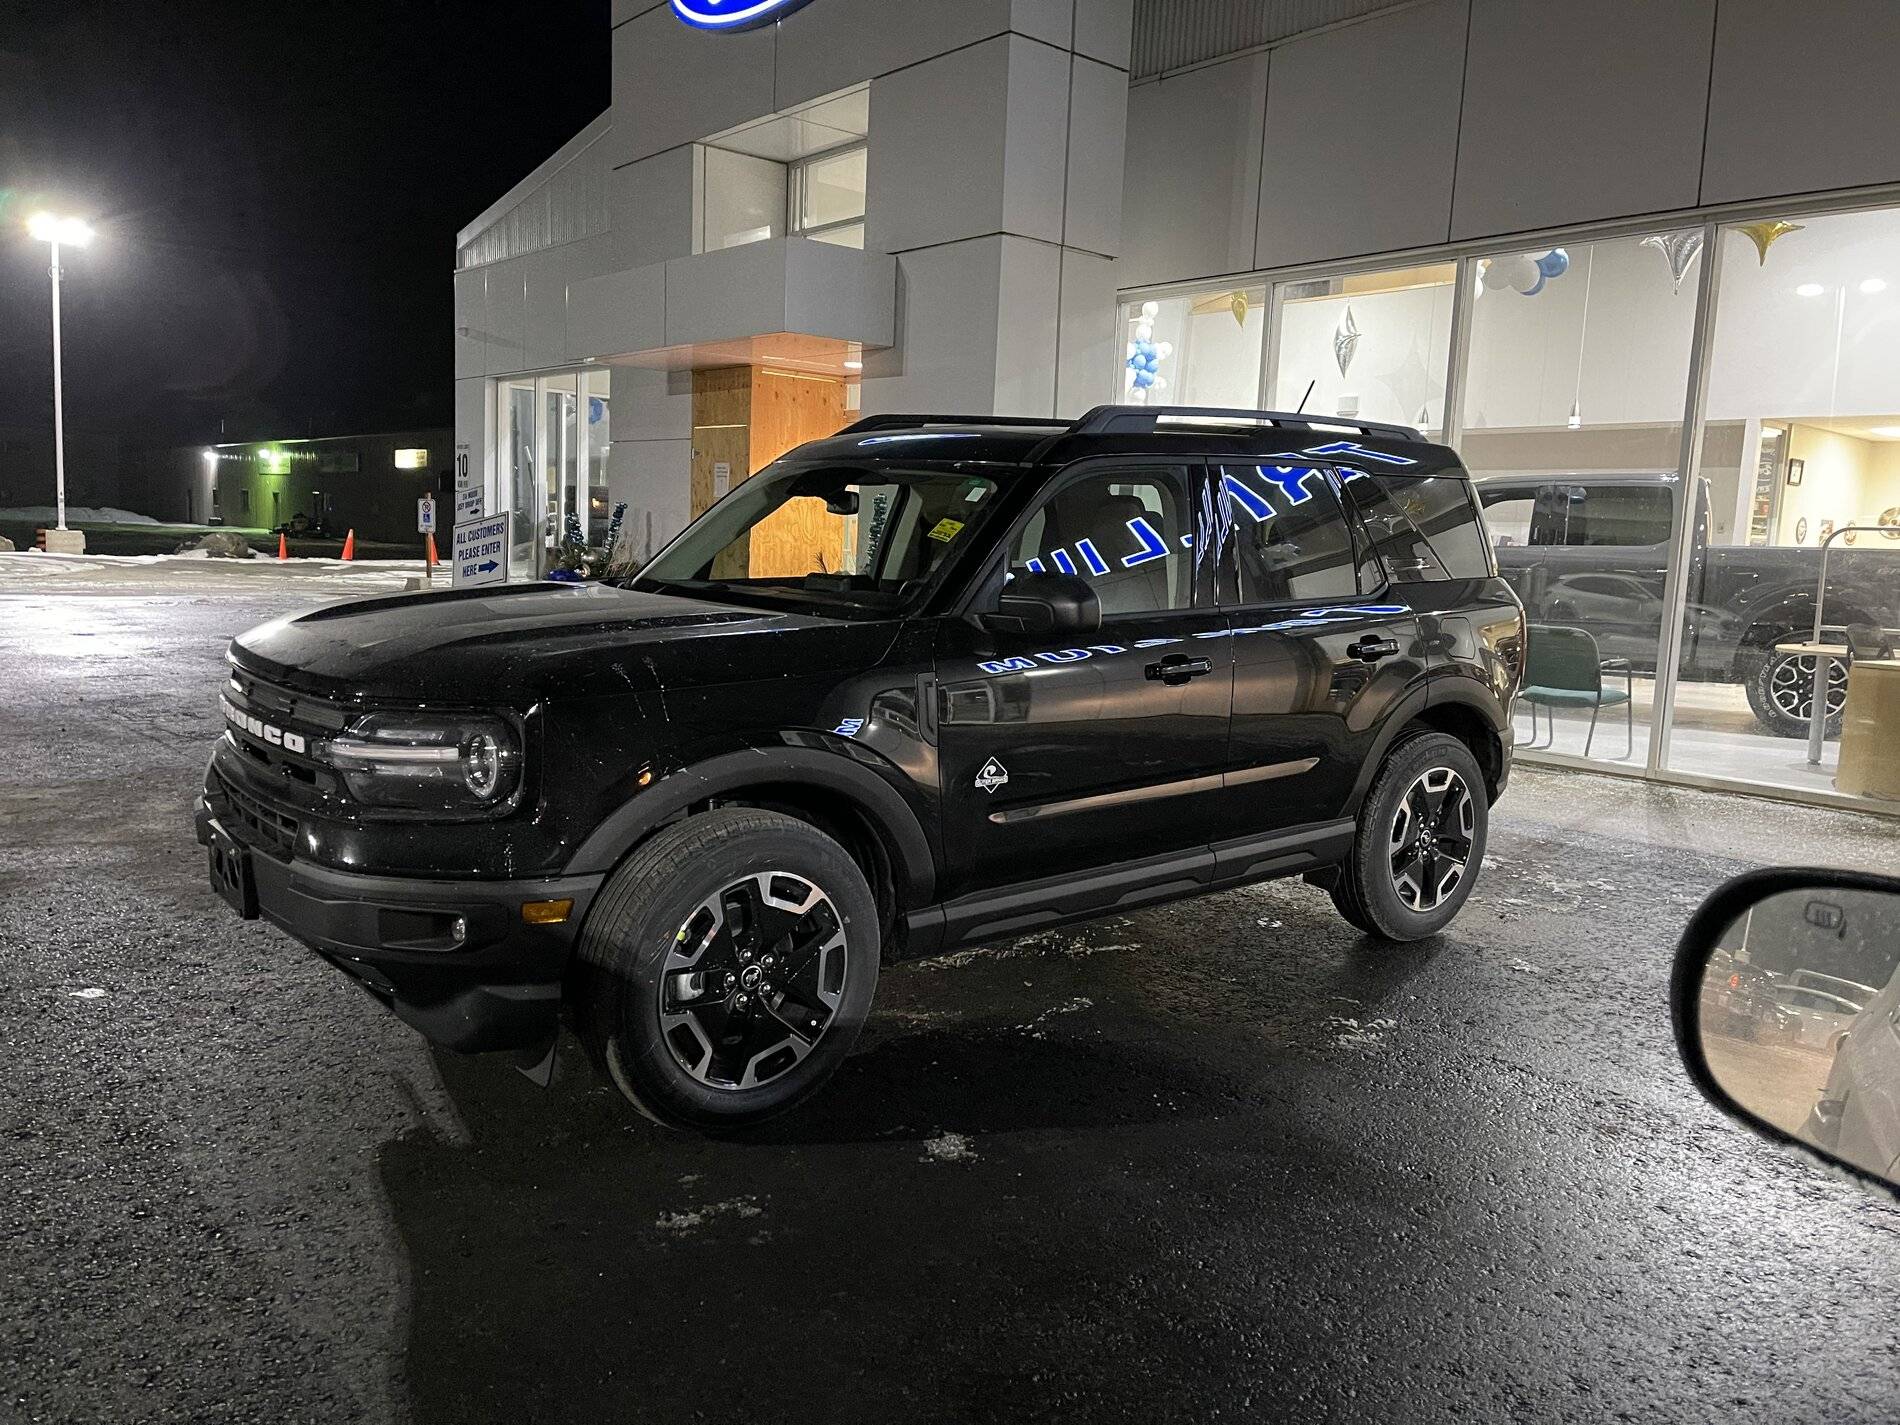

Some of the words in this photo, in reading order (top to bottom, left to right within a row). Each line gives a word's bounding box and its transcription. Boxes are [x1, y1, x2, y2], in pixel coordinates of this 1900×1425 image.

[456, 453, 468, 477] 10
[456, 532, 467, 545] ALL
[468, 522, 504, 542] CUSTOMERS
[458, 546, 480, 561] PLEASE
[481, 541, 501, 556] ENTER
[463, 563, 478, 578] HERE
[222, 701, 305, 754] RONCO
